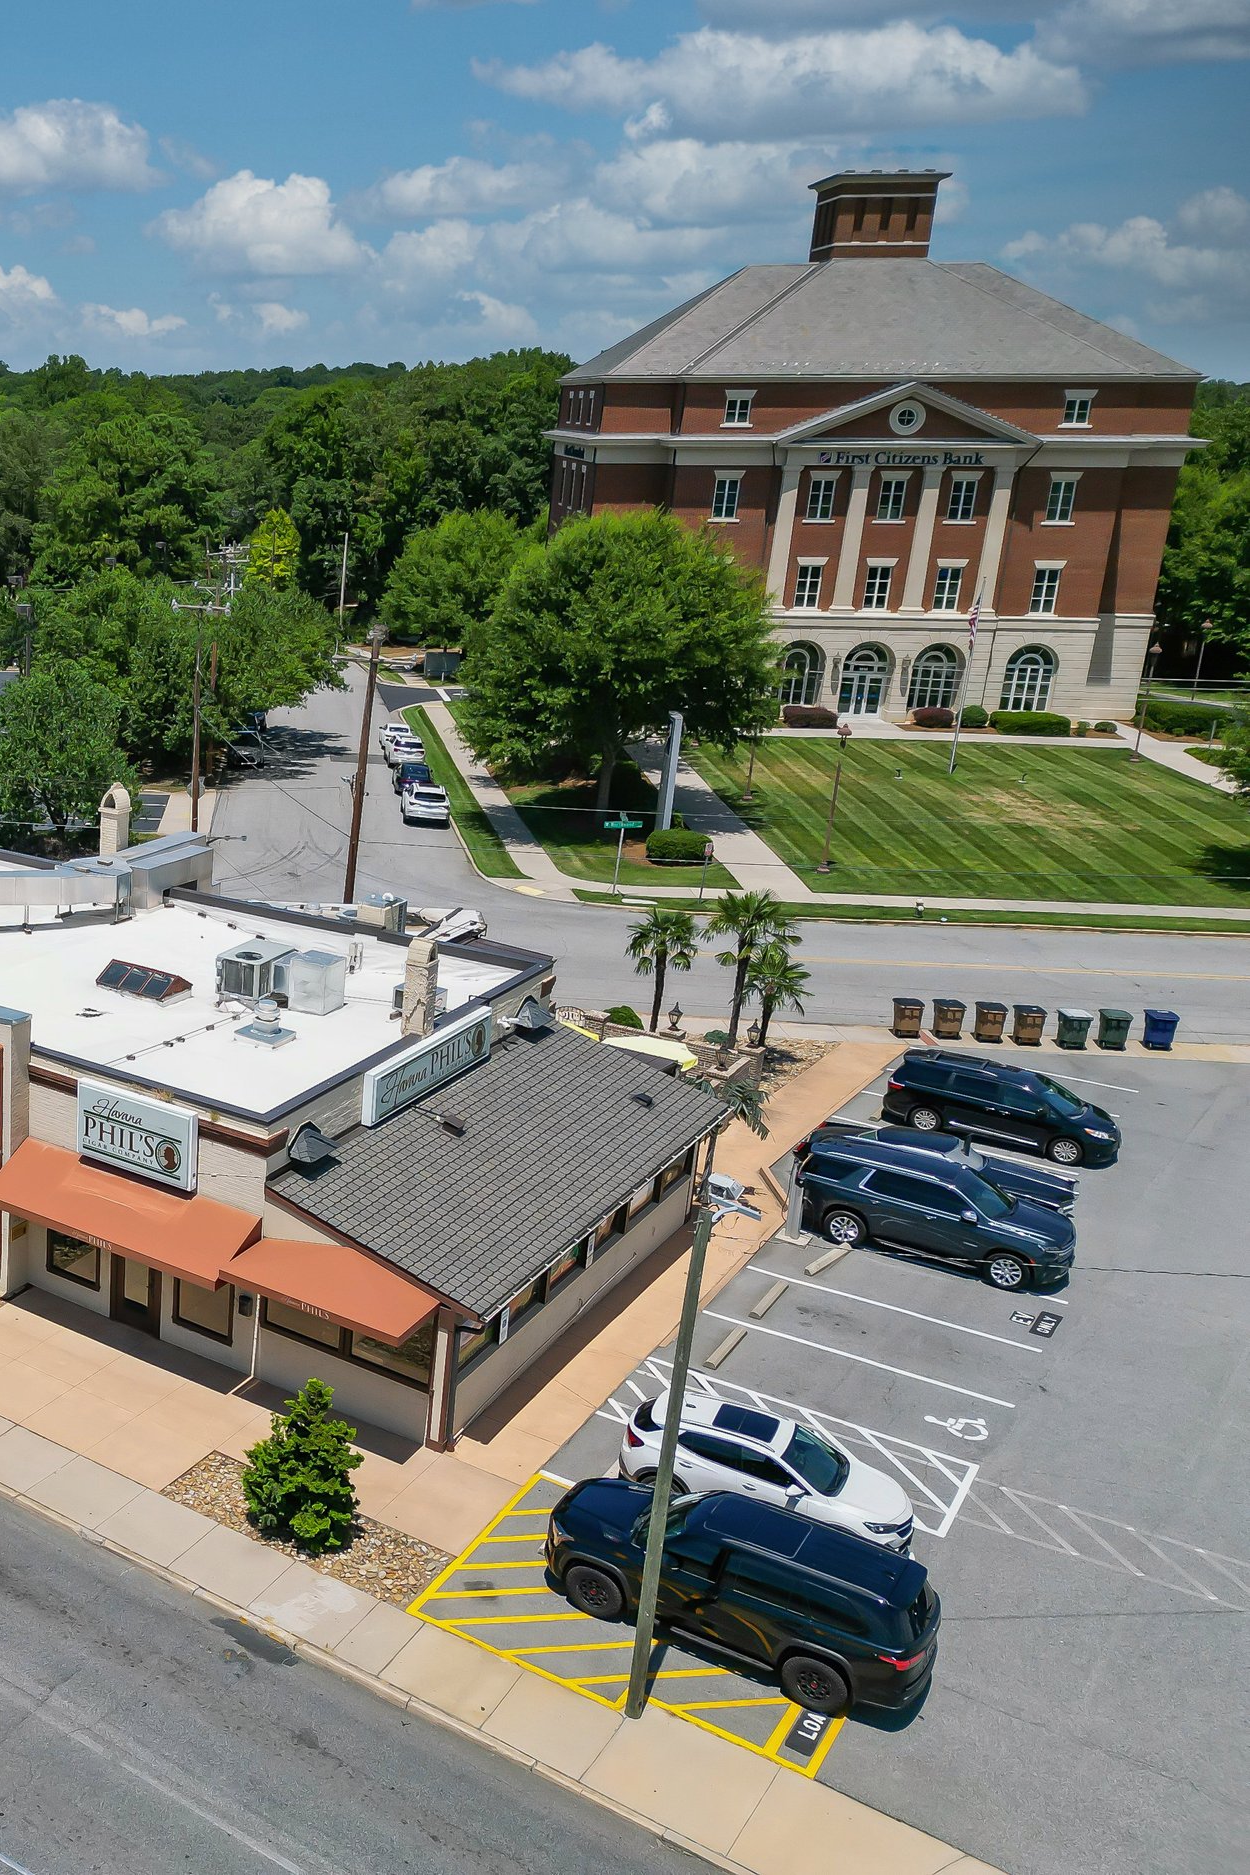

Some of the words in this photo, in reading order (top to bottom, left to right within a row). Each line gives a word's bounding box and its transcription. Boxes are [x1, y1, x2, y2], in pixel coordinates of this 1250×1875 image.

[835, 451, 871, 464] First
[874, 451, 939, 464] Citizens
[941, 451, 984, 465] Bank
[381, 1065, 427, 1106] Havana
[430, 1030, 471, 1075] PHIL'S
[92, 1098, 142, 1125] Havana
[83, 1115, 155, 1157] PHIL'S
[83, 1137, 108, 1150] CIGAR
[112, 1144, 154, 1165] COMPANY
[1011, 1311, 1034, 1326] EV
[1036, 1315, 1057, 1334] ONLY
[796, 1712, 827, 1740] LOA
